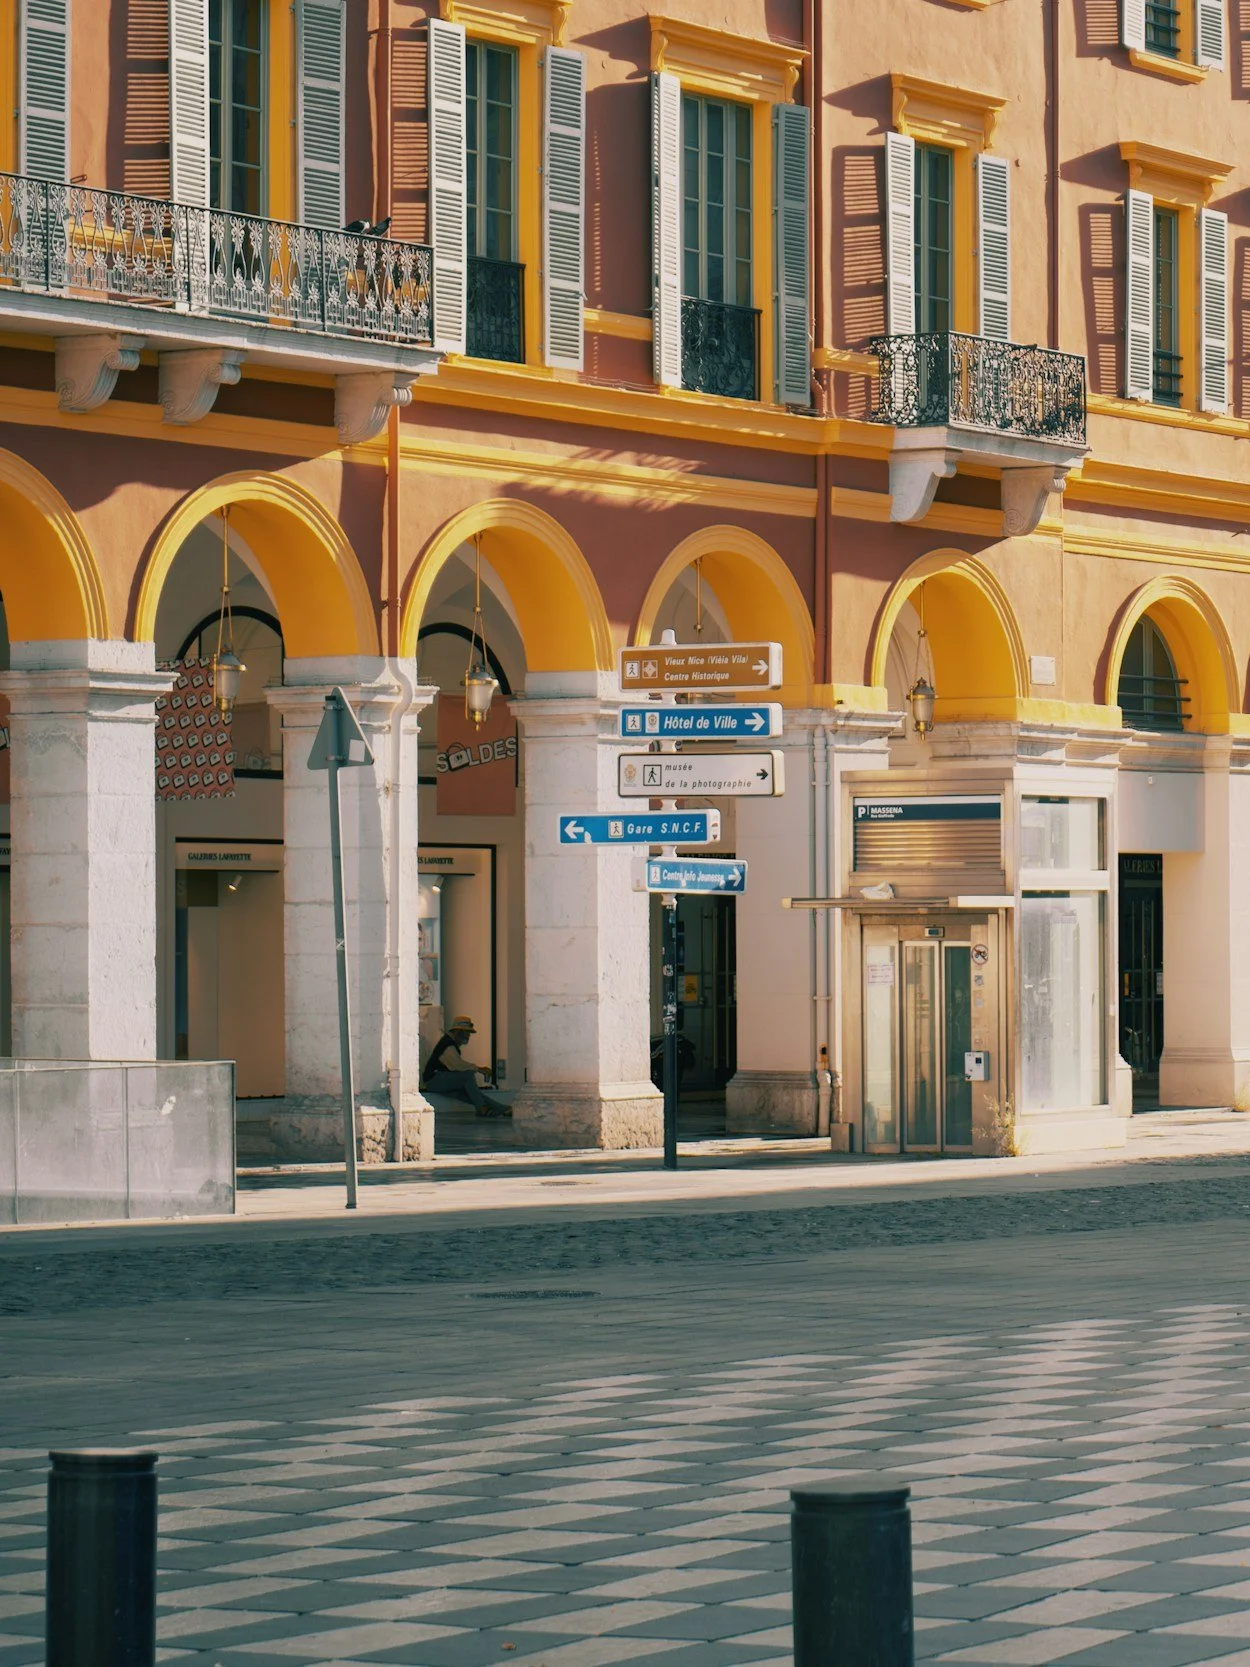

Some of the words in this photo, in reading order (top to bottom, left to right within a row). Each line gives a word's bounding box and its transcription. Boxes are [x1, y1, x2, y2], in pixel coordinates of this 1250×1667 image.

[665, 656, 685, 665] Vieux
[688, 655, 704, 664] Nice
[664, 672, 689, 681] Centre
[692, 671, 729, 682] Historique
[664, 715, 694, 729] Hôtel
[696, 715, 710, 729] de
[714, 715, 738, 729] Ville
[665, 780, 675, 788] de
[680, 780, 688, 788] la
[692, 780, 752, 789] photographie
[858, 806, 866, 818] P
[627, 823, 653, 834] Gare
[660, 822, 704, 834] S.N.C.F.
[187, 852, 218, 860] GALERIES
